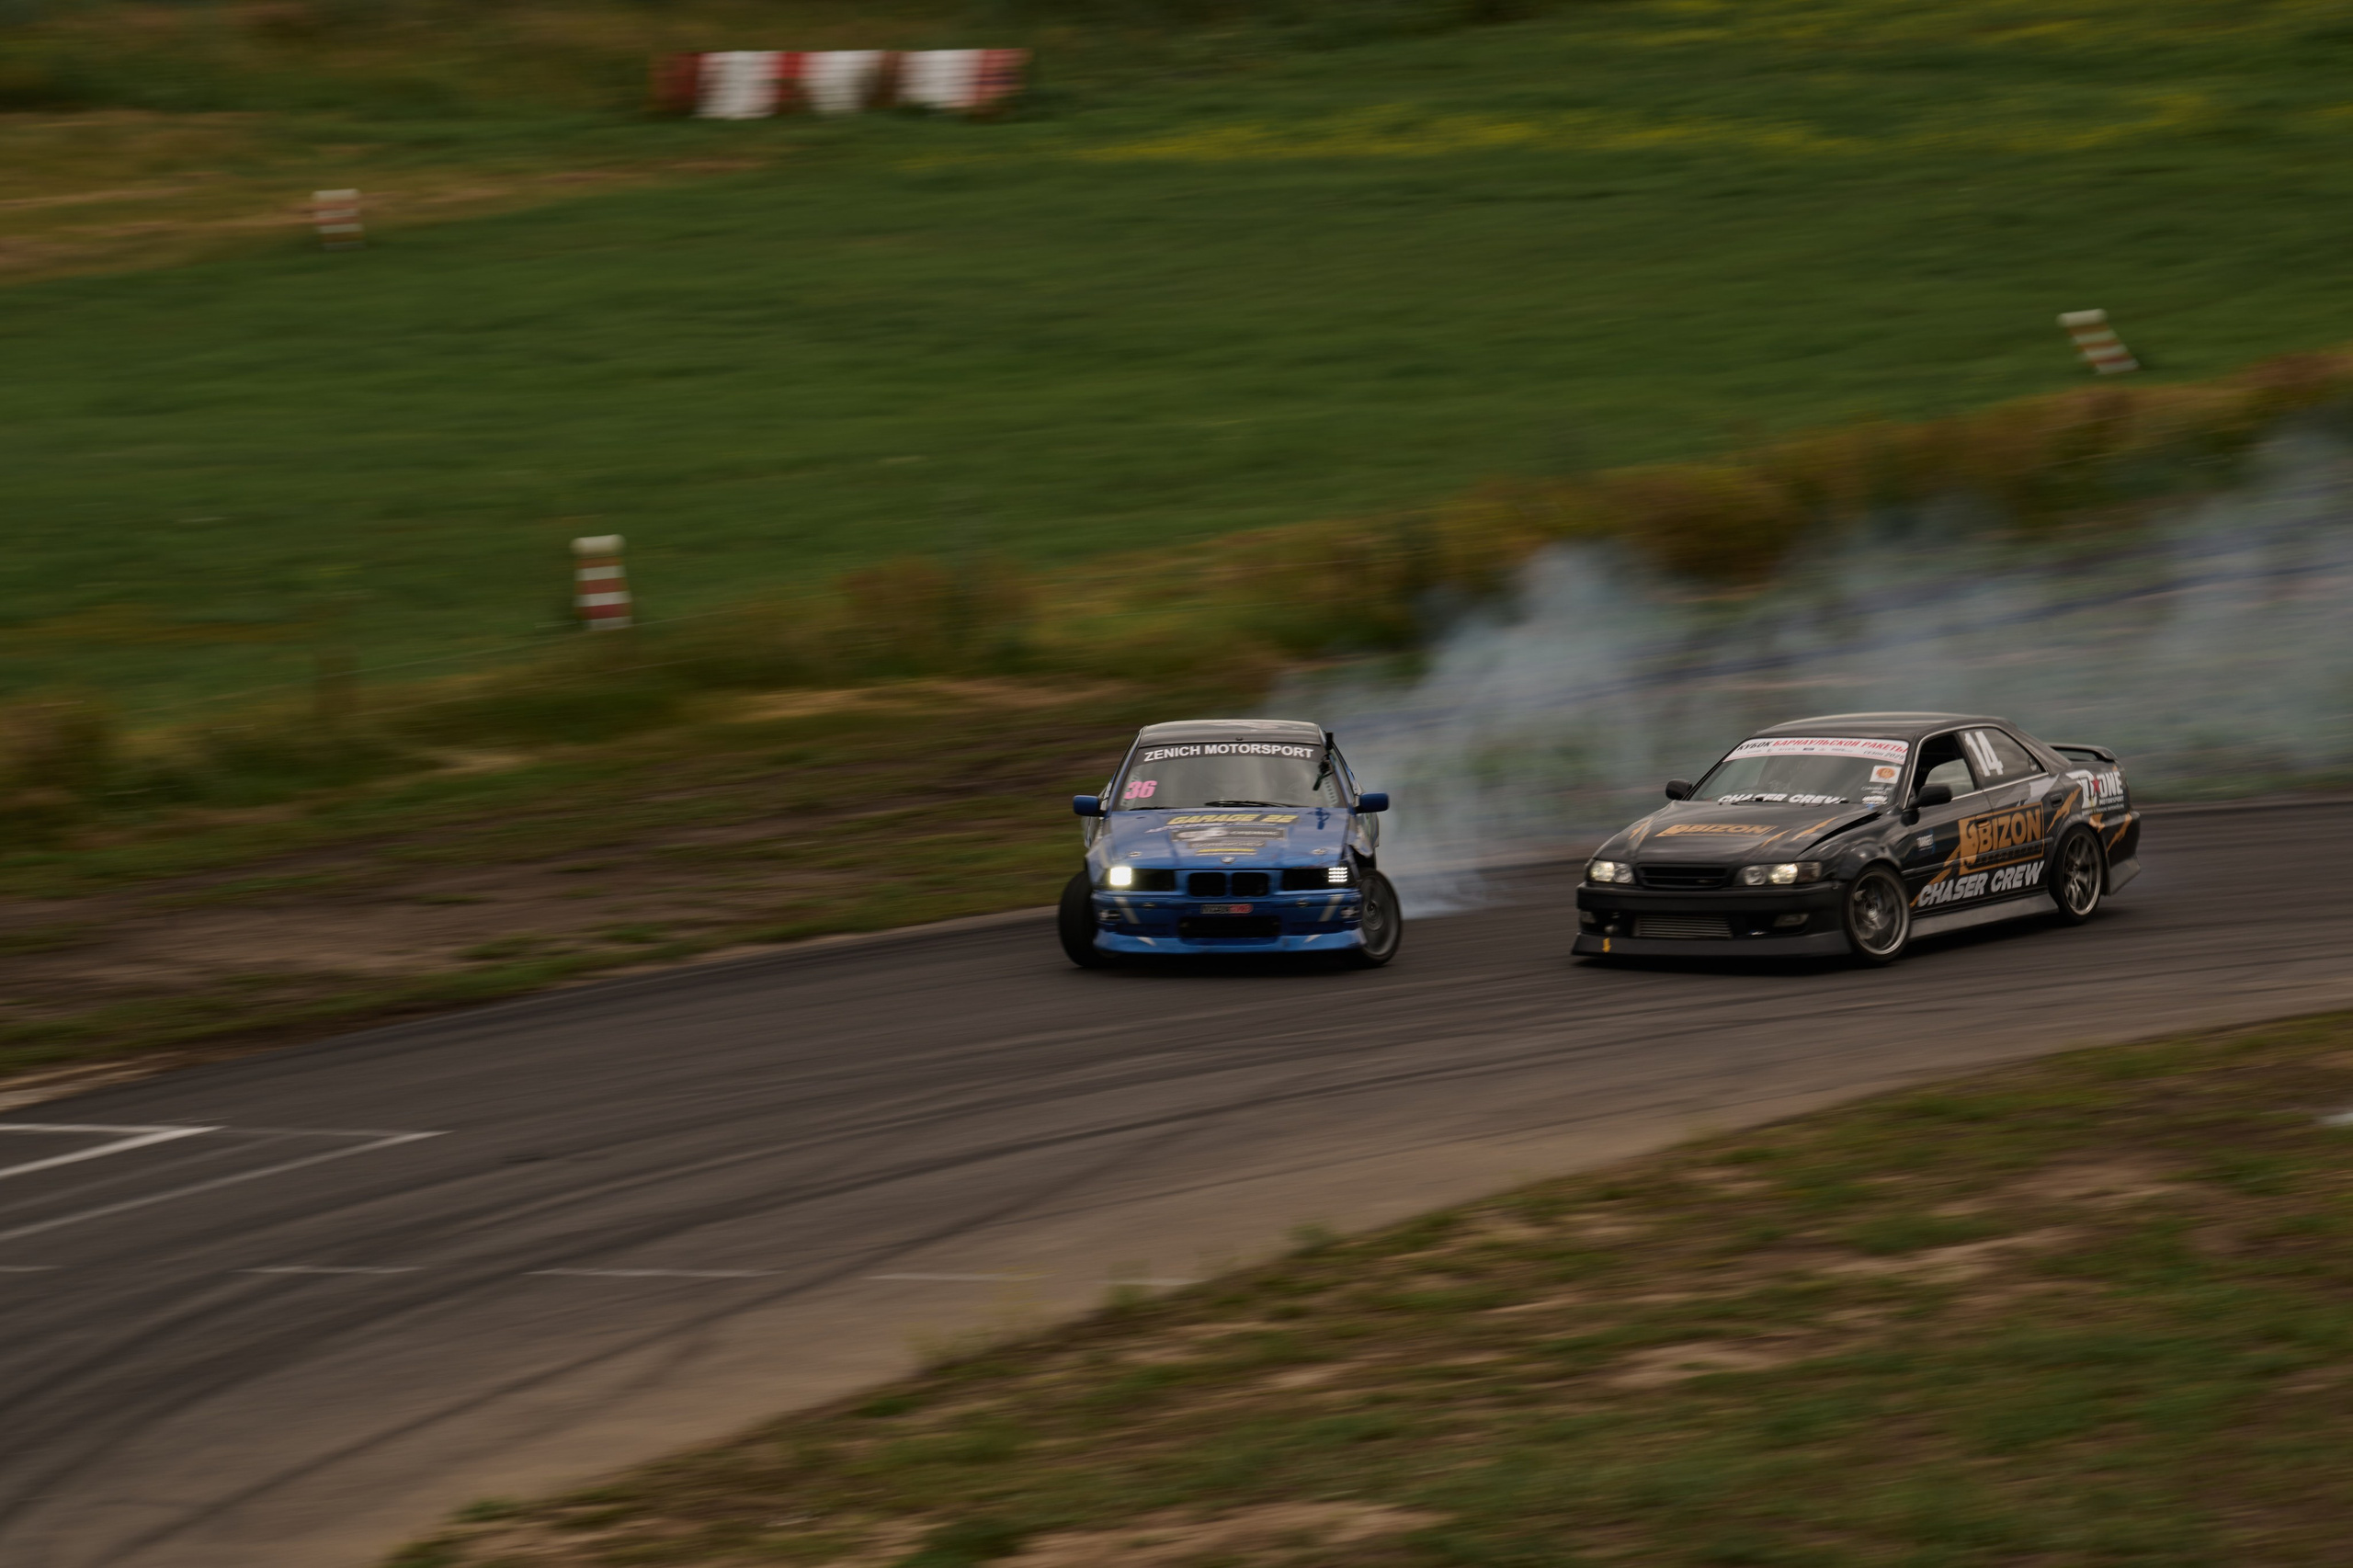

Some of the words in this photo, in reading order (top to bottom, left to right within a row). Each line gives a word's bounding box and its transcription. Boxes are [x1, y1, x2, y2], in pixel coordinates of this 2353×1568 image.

[1143, 745, 1201, 762] ZENICH
[1204, 744, 1314, 758] MOTORSPORT
[1736, 740, 1773, 752] КУБОК
[1772, 739, 1861, 748] БАРНАУЛЬСКОЙ
[1964, 731, 2004, 778] 14
[1123, 780, 1158, 800] 36
[1165, 813, 1262, 825] GARAGE
[1260, 814, 1299, 824] 22
[1978, 808, 2041, 853] BIZON
[1917, 872, 1989, 907] CHASER
[1990, 859, 2045, 893] CREW
